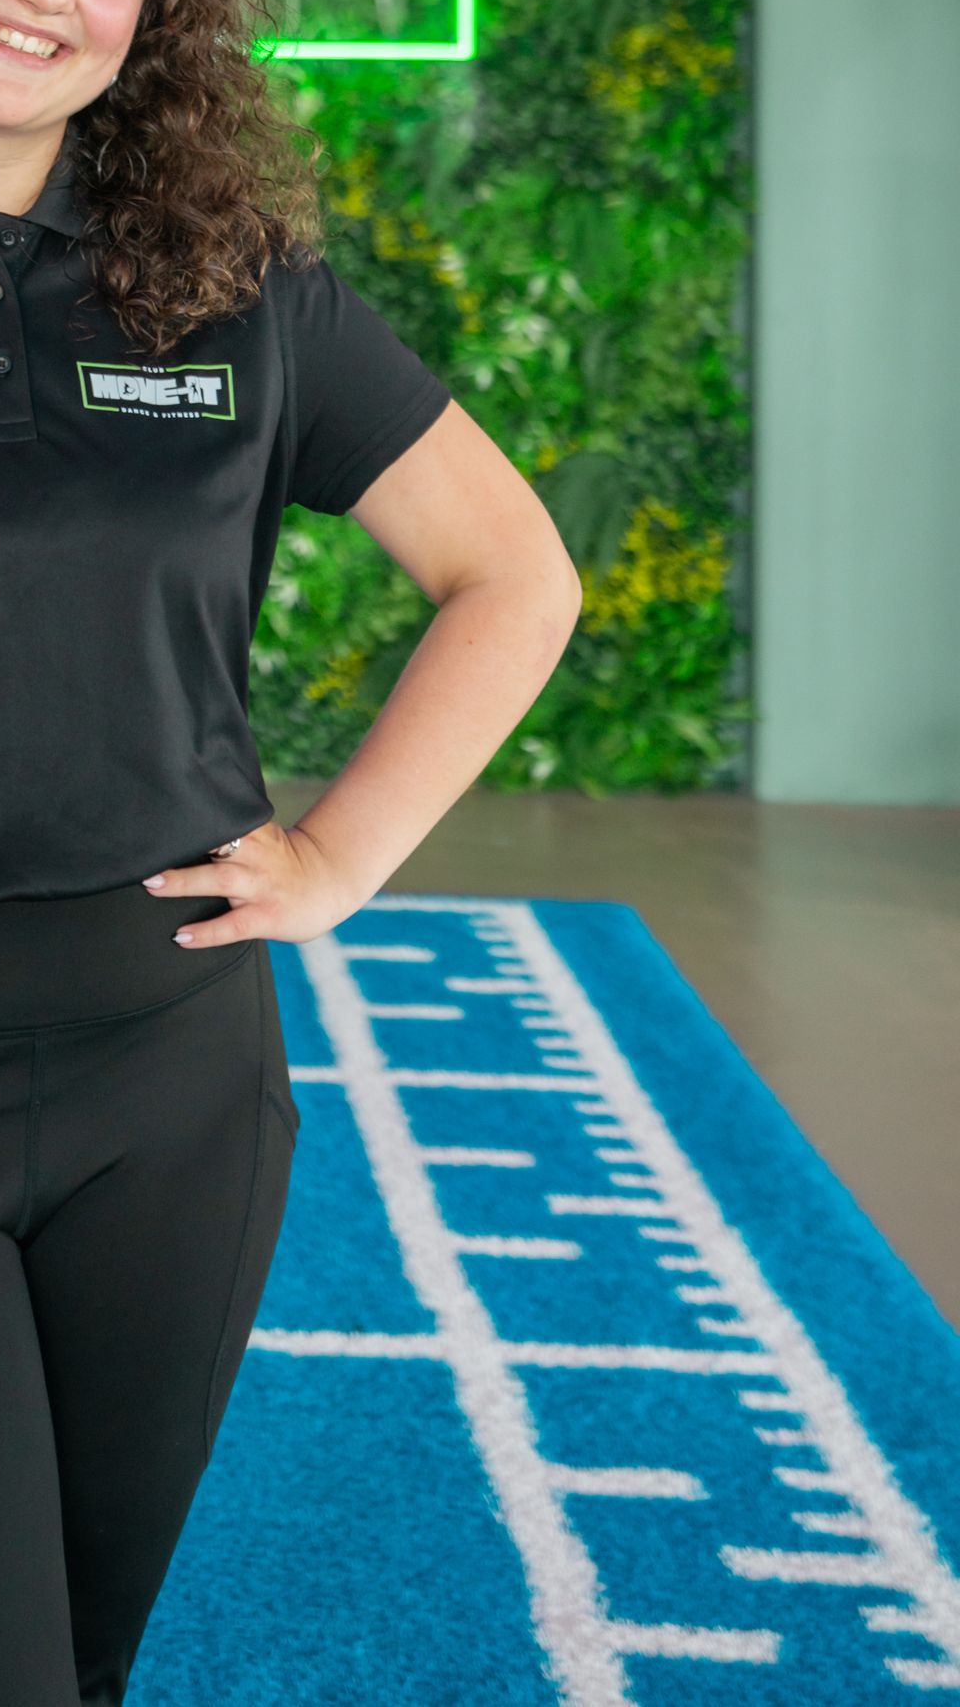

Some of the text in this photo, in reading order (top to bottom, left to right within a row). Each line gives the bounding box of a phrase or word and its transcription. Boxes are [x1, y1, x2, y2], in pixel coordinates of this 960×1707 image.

[142, 365, 165, 374] CLUB
[89, 373, 222, 406] MOVE-IT
[120, 406, 150, 417] DANCE
[161, 411, 200, 419] FITNESS
